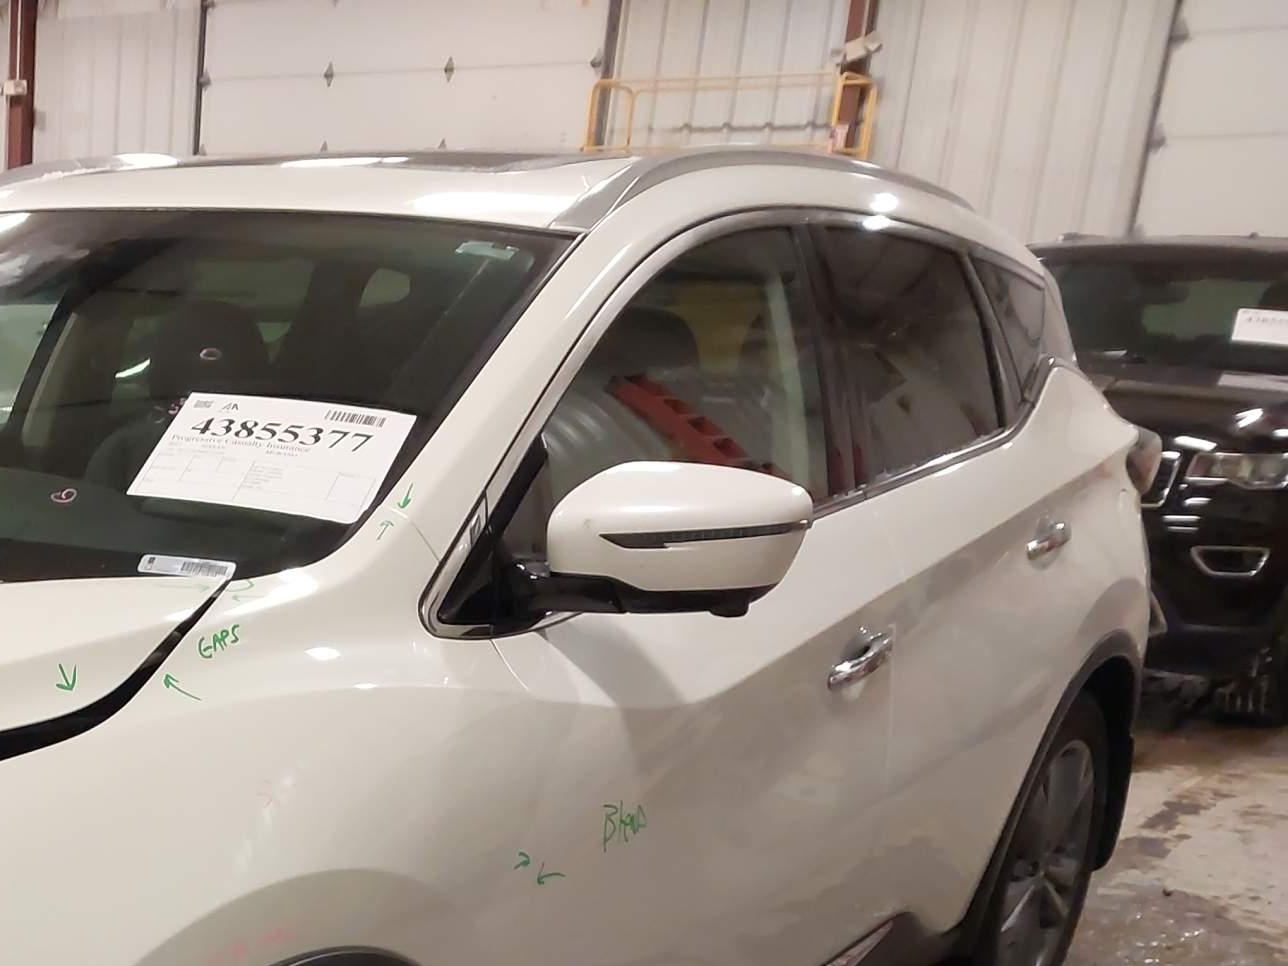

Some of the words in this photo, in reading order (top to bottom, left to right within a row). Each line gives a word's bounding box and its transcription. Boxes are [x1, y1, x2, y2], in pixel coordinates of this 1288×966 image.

[191, 417, 374, 452] 43855377
[225, 438, 263, 448] Casualty
[266, 441, 311, 452] Insurance
[198, 624, 240, 659] GAPS
